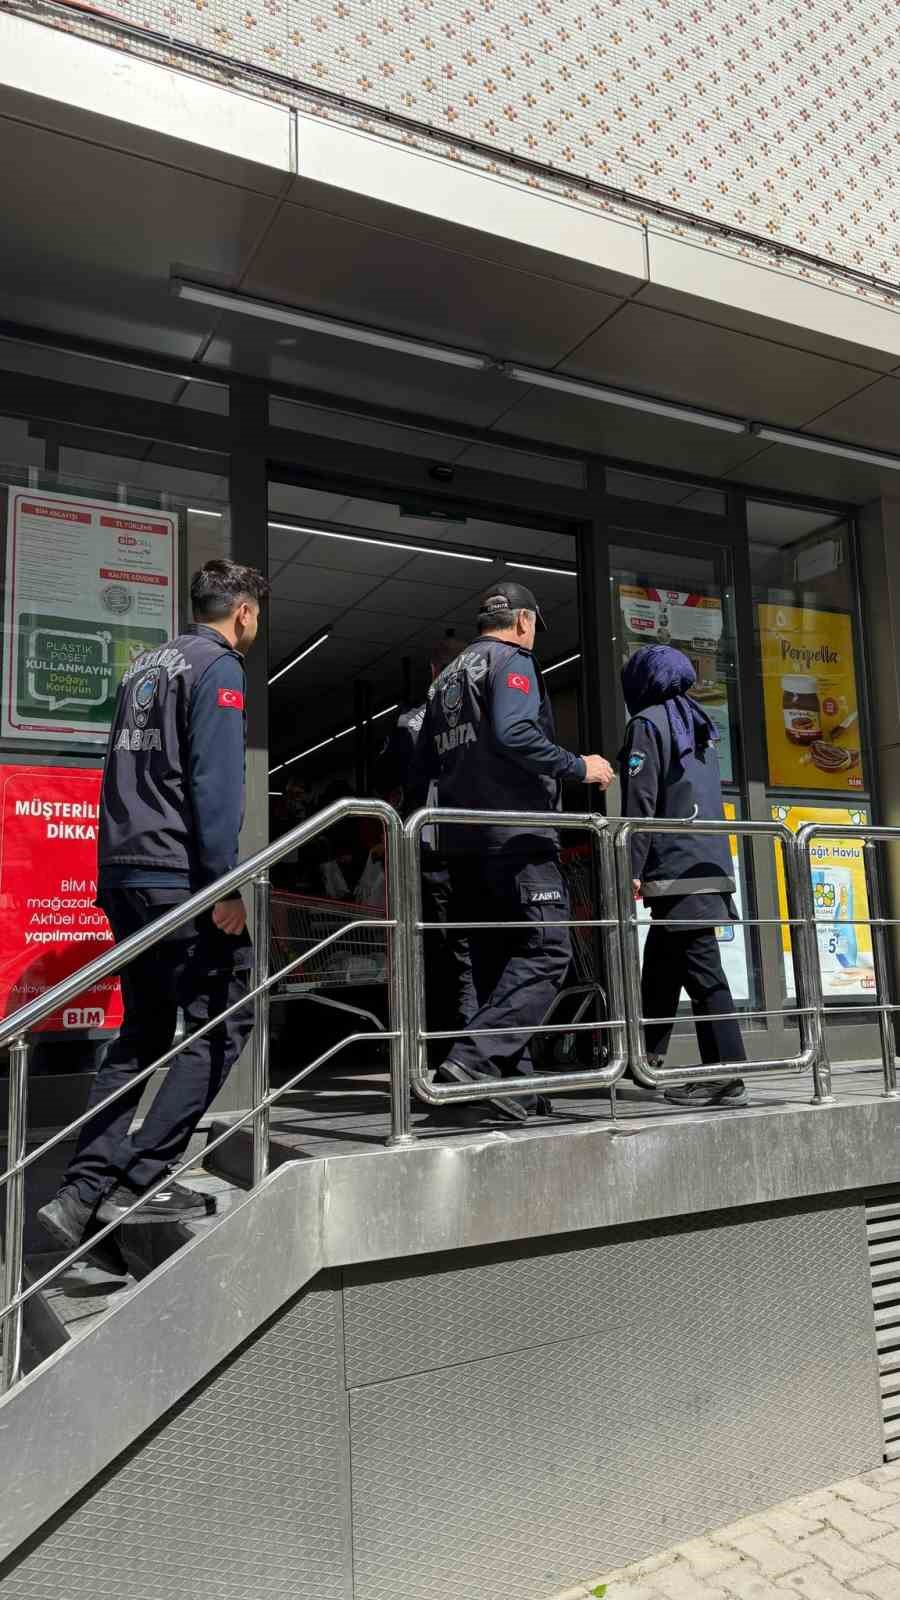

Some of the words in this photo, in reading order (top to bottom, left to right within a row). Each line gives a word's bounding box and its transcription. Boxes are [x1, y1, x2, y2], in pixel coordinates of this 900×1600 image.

[25, 659, 112, 676] KULLANMAYIN
[61, 876, 86, 892] BİM
[30, 912, 75, 925] Aktüel
